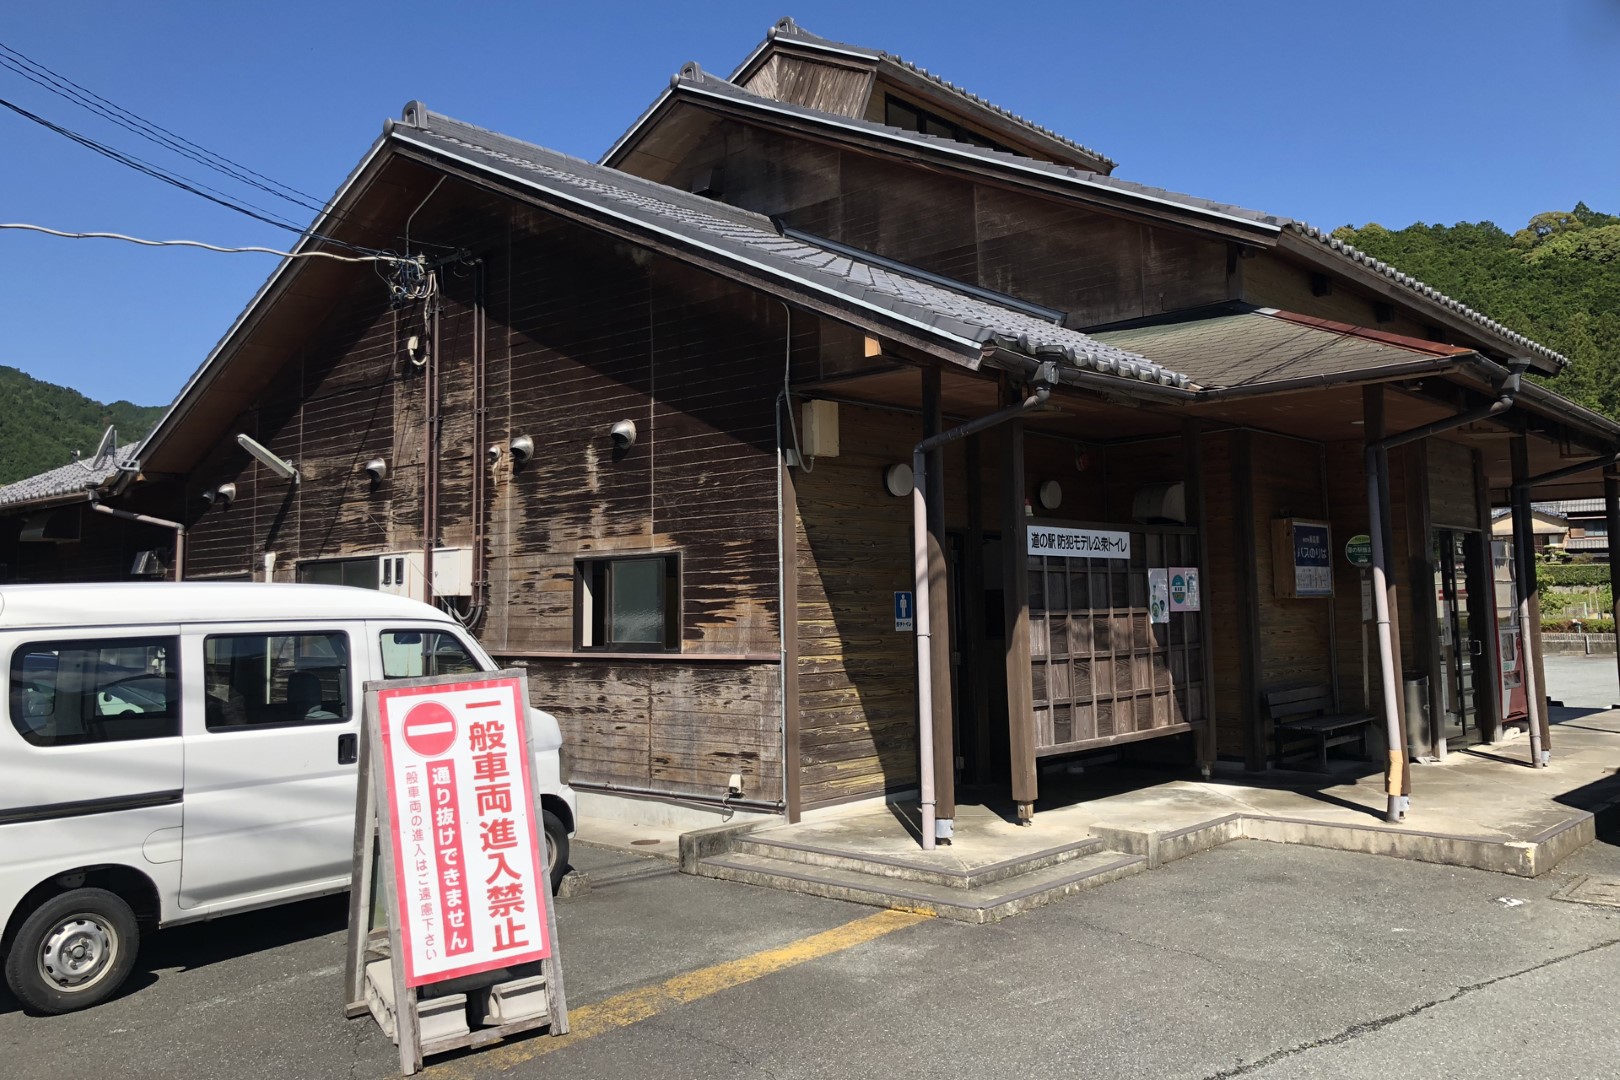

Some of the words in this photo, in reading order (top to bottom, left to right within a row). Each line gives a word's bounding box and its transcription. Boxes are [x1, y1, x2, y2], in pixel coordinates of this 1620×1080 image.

[404, 764, 437, 960] 一般車両の進入はご遠慮下さい
[431, 766, 468, 951] 通り抜けできません
[465, 700, 529, 953] 一般車両進入禁止
